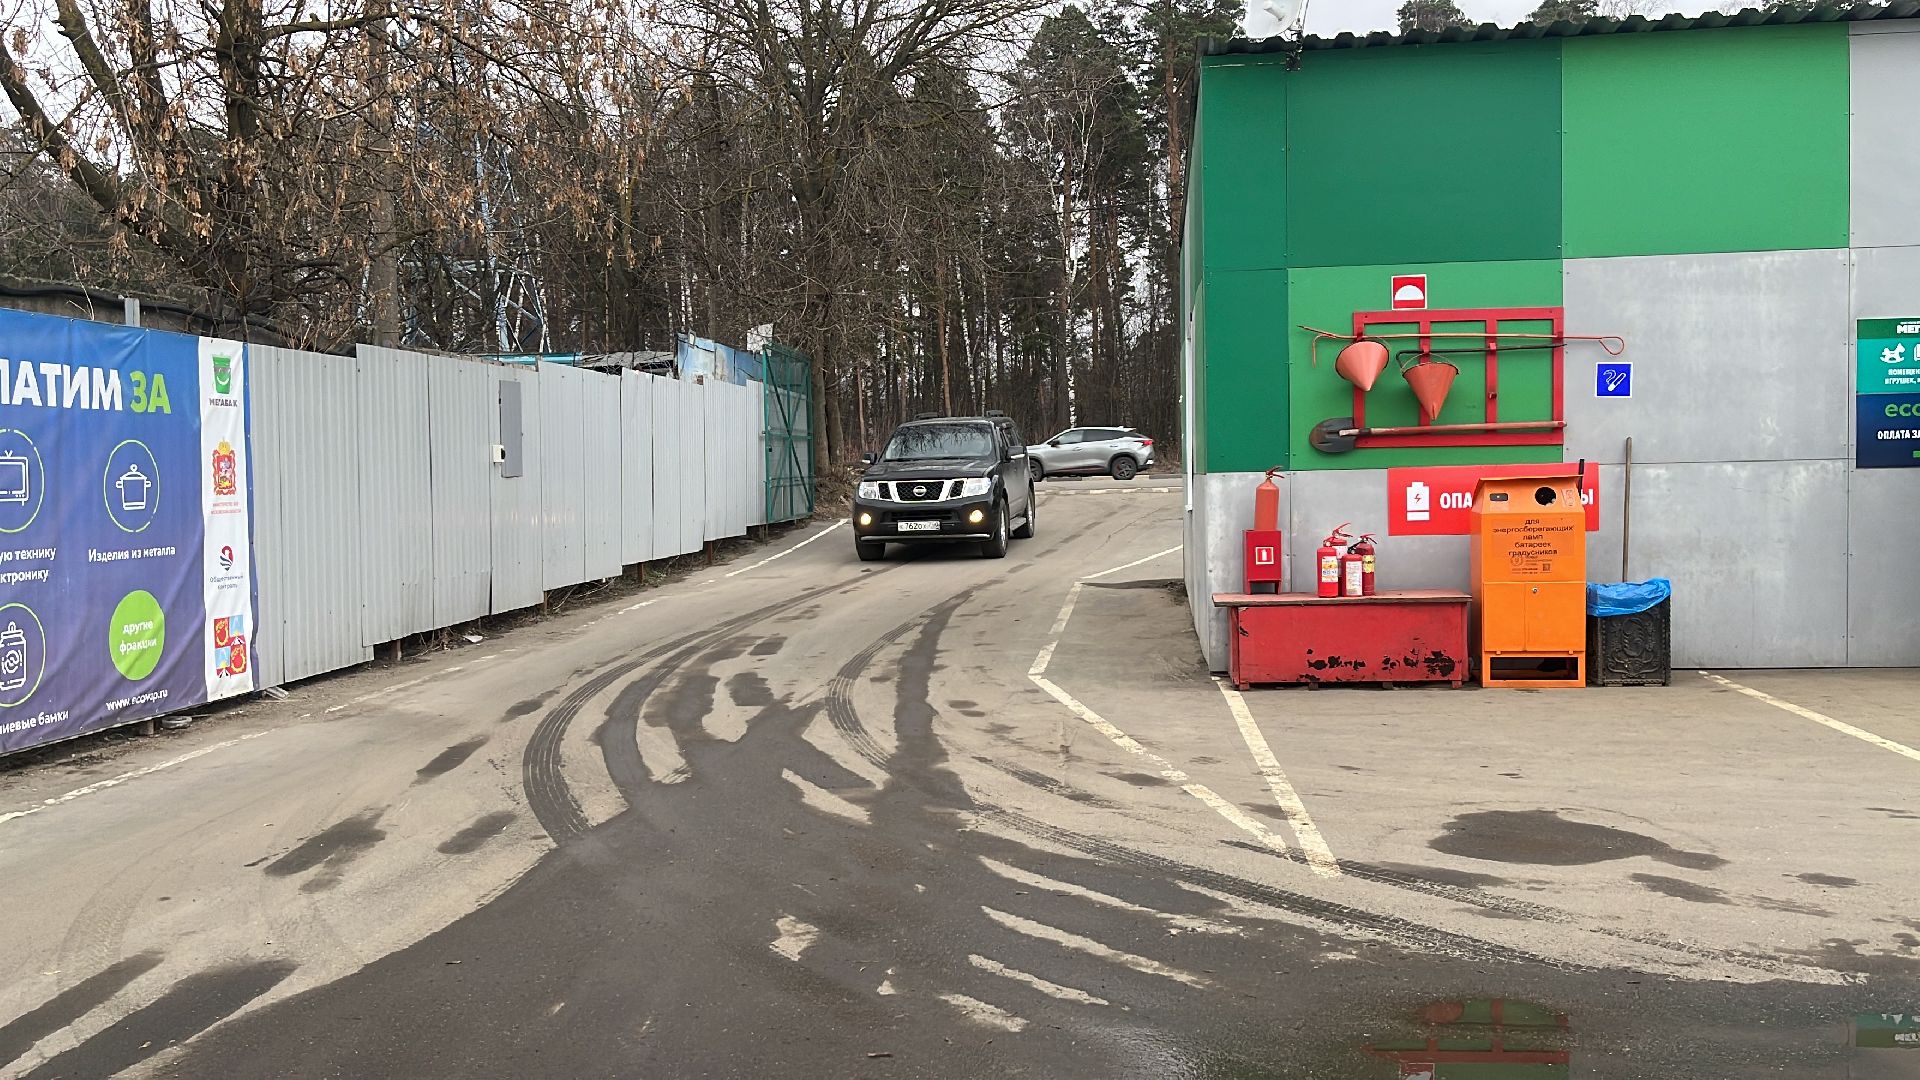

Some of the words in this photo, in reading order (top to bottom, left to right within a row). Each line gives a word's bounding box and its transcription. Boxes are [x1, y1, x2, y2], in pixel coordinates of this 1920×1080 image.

[130, 371, 171, 414] ЗА
[1877, 429, 1911, 440] ОПЛАТА
[1492, 525, 1574, 534] энергосберегающих
[14, 547, 57, 561] технику
[88, 548, 130, 563] Изделия
[131, 549, 142, 559] из
[143, 546, 176, 558] металла
[1508, 549, 1558, 558] градусников
[123, 620, 154, 636] другие
[119, 639, 157, 656] фракции
[38, 710, 69, 726] банки
